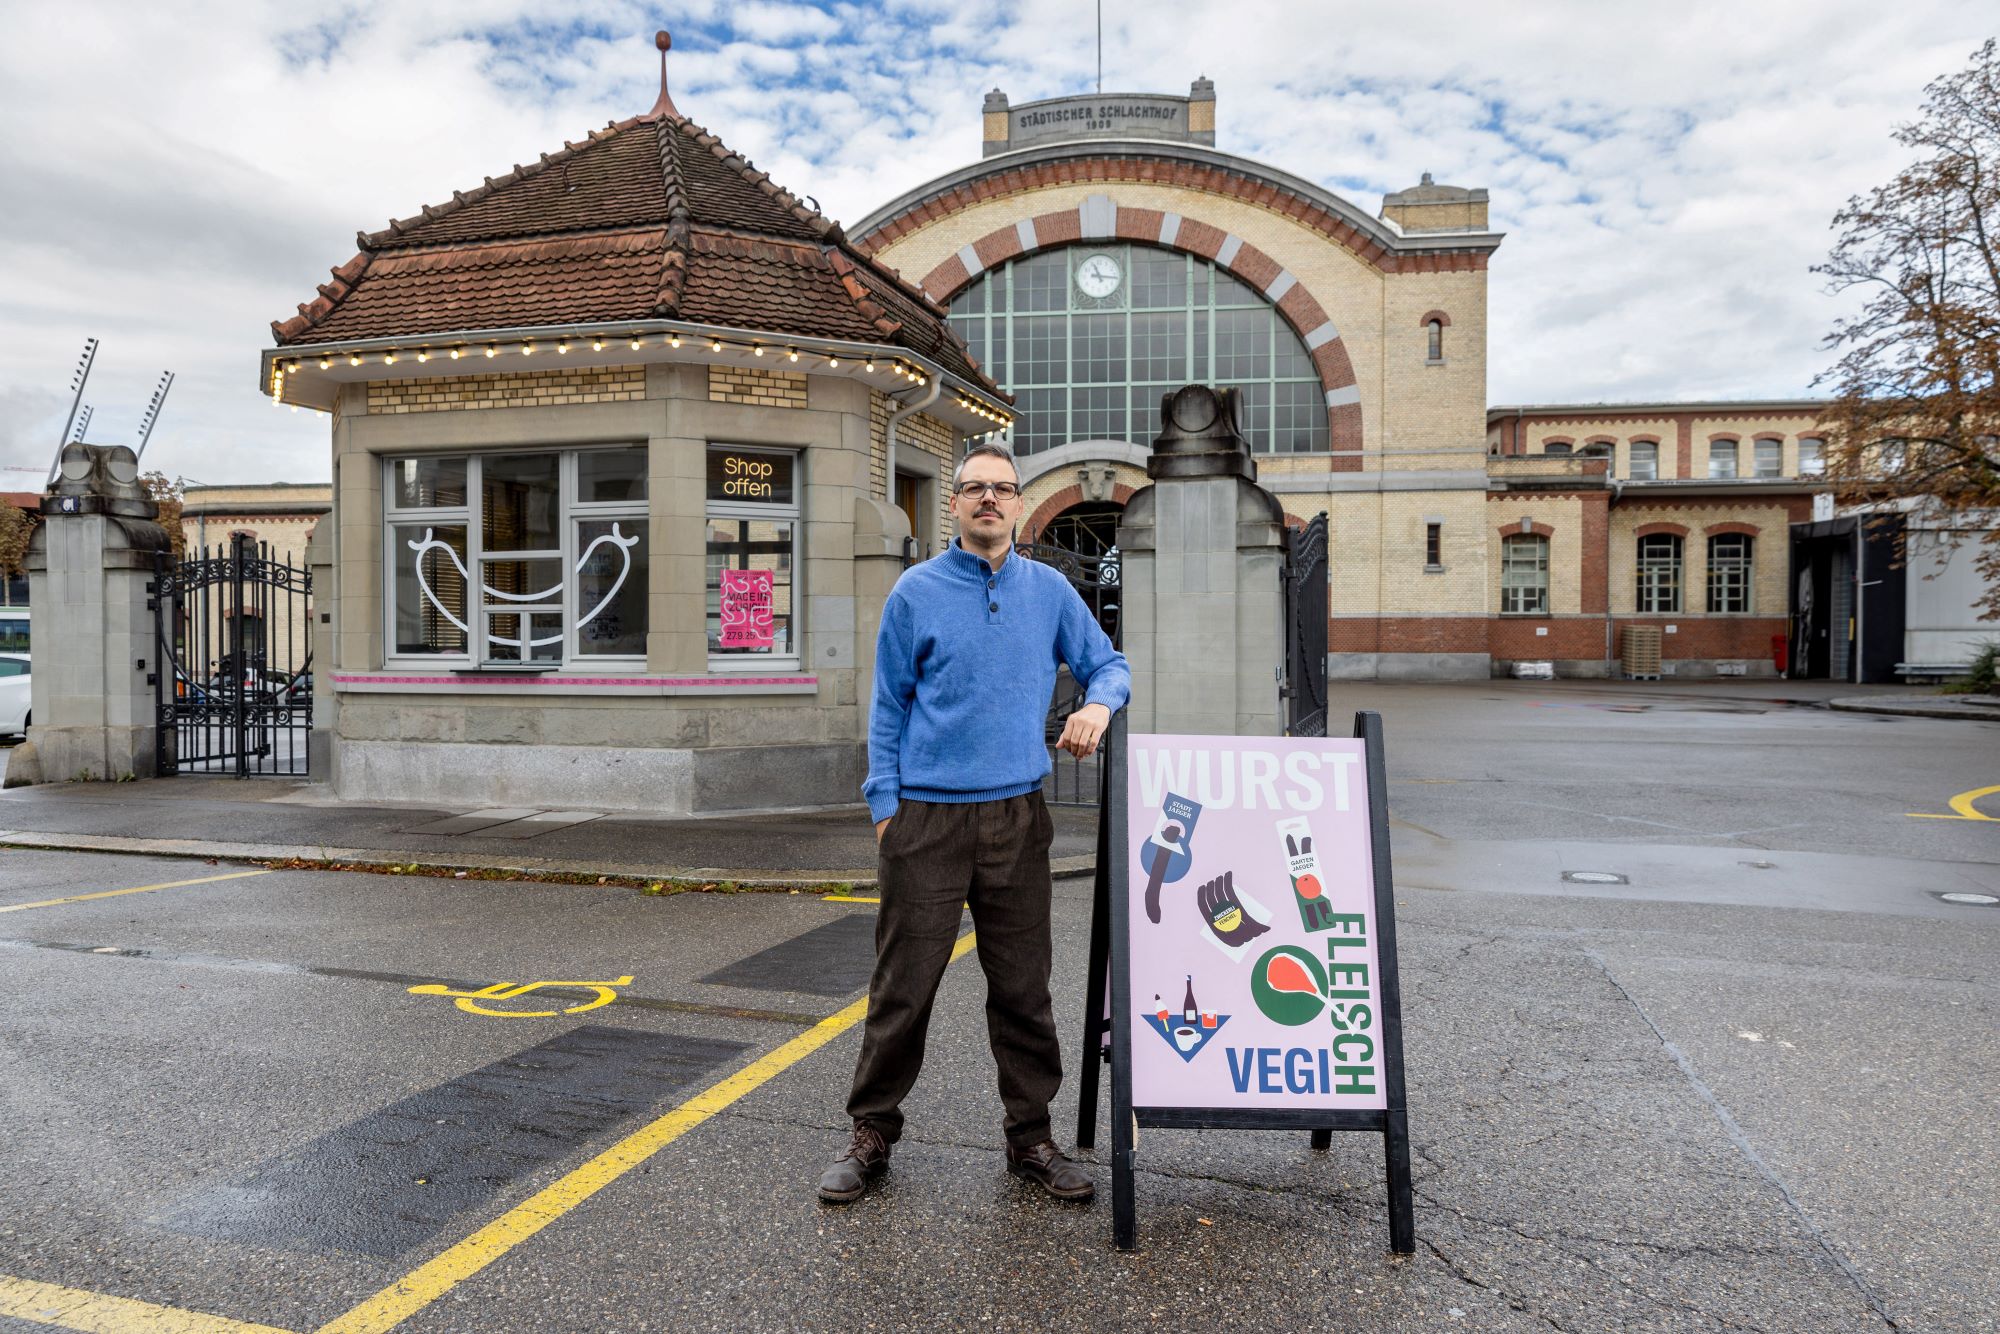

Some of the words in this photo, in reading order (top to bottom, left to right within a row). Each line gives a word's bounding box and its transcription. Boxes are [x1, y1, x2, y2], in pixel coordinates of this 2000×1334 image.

[1020, 107, 1092, 128] STÄDTISCHER
[1099, 106, 1177, 120] SCHLACHTHOF
[1086, 120, 1111, 130] 1909
[724, 457, 773, 480] Shop
[723, 478, 771, 497] offen
[1135, 748, 1359, 811] WURST
[1168, 806, 1192, 819] JAEGER
[1172, 801, 1193, 812] STADT
[1290, 857, 1314, 866] GARTEN
[1292, 863, 1314, 872] JAEGER
[1326, 913, 1376, 1094] FLEISCH
[1225, 1047, 1330, 1094] VEGI
